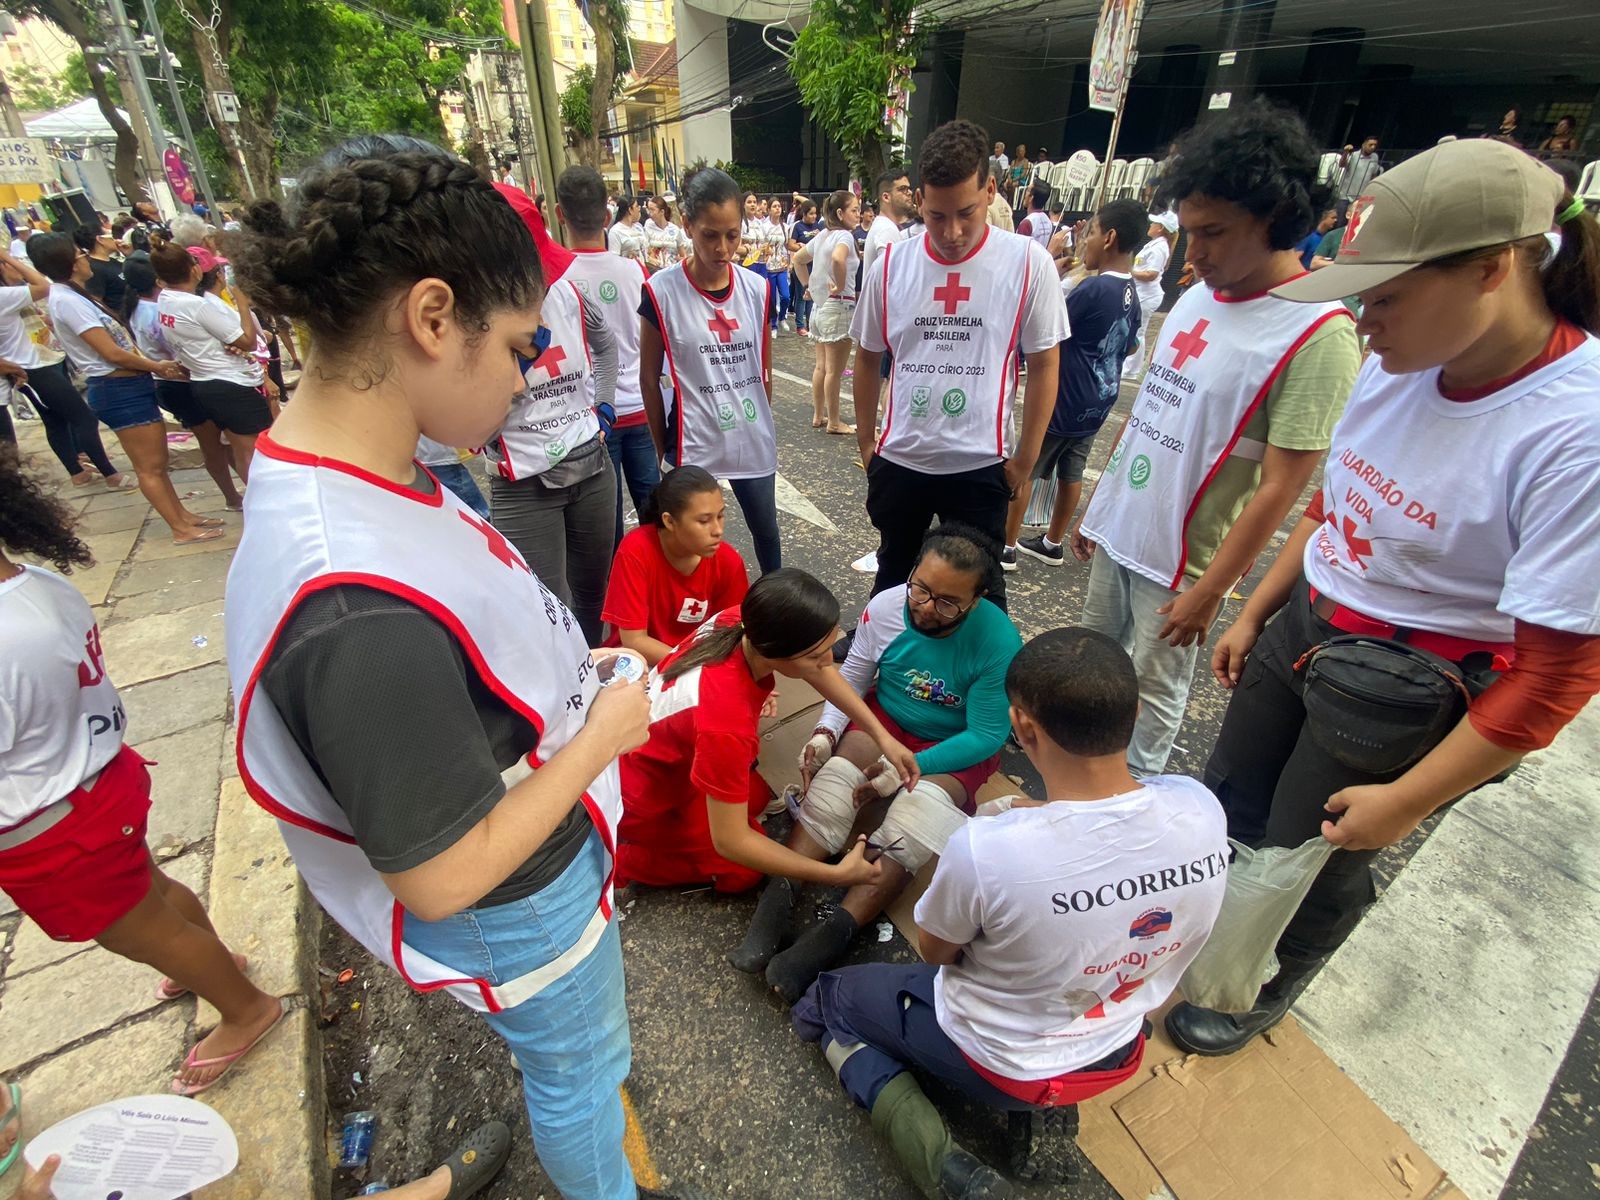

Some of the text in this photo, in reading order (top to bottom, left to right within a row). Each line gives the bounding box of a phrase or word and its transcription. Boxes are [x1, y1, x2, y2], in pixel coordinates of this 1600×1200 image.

[914, 316, 983, 328] CRUZ VERMELHA
[923, 331, 971, 341] BRASILEIRA
[717, 341, 753, 354] VERMELHA
[935, 343, 954, 352] PARÁ
[709, 354, 747, 366] BRSILEIRA
[900, 362, 986, 376] PROJETO CÍRIO 2023
[698, 376, 762, 394] PROJETO ÍRIO 2023
[1146, 381, 1182, 409] RASILEIRA
[549, 398, 567, 409] PARÁ
[561, 411, 581, 427] CÍRIO
[1140, 421, 1160, 441] CÍRIO
[1160, 434, 1185, 454] 2023
[1339, 447, 1438, 531] UARDIÃO DA
[1344, 486, 1374, 525] VIDA
[1051, 850, 1226, 915] SOCORRISTA
